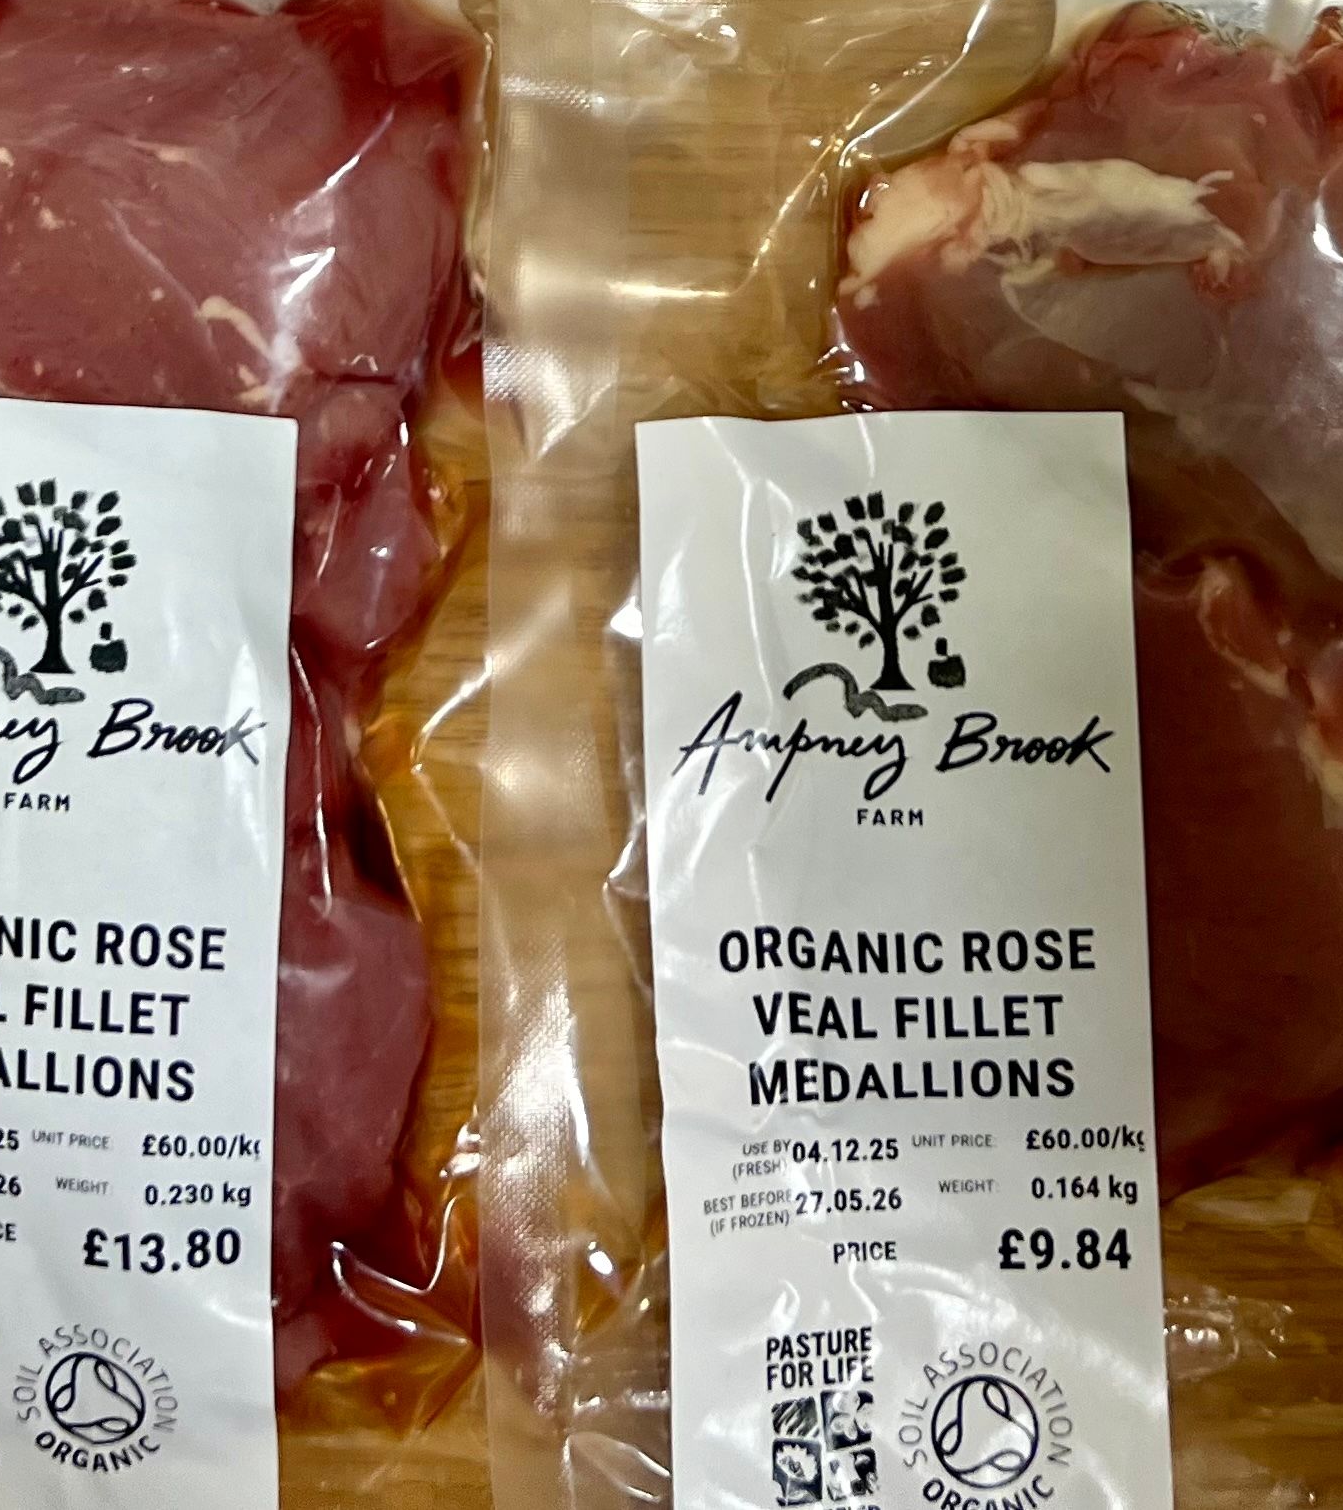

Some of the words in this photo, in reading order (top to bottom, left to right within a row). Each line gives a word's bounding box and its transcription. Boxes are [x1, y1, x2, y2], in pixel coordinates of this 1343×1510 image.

[87, 698, 267, 765] Brook
[671, 690, 907, 802] Ampney
[935, 712, 1116, 773] Brook
[4, 792, 70, 812] FARM
[856, 808, 924, 827] FARM
[95, 921, 227, 971] ROSE
[719, 926, 944, 974] ORGANIC
[962, 928, 1096, 973] ROSE
[24, 983, 190, 1037] FILLET
[753, 992, 877, 1039] VEAL
[894, 994, 1063, 1039] FILLET
[749, 1058, 1075, 1106] MEDALLIONS
[32, 1129, 64, 1145] UNIT
[742, 1141, 768, 1156] USE
[773, 1139, 791, 1153] BY
[792, 1137, 899, 1163] 04.12.25
[912, 1133, 945, 1148] UNIT
[145, 1183, 214, 1206] 0.230
[222, 1181, 252, 1208] kg
[703, 1199, 735, 1216] BEST
[741, 1188, 792, 1209] BEFORE
[795, 1187, 903, 1216] 27.05.26
[1031, 1175, 1100, 1199] 0.164
[1109, 1174, 1138, 1205] kg
[710, 1218, 727, 1237] (IF
[83, 1227, 242, 1275] £13.80
[833, 1241, 897, 1265] PRICE
[998, 1227, 1131, 1270] £9.84
[766, 1326, 873, 1361] PASTURE
[13, 1363, 44, 1423] SOIL
[38, 1323, 179, 1432] ASSOCIATION
[766, 1363, 814, 1390] FOR
[821, 1355, 875, 1386] LIFE
[898, 1397, 929, 1468] SOIL
[923, 1341, 1073, 1467] ASSOCIATION
[35, 1431, 161, 1473] ORGANIC
[922, 1474, 1055, 1510] ORGANIC
